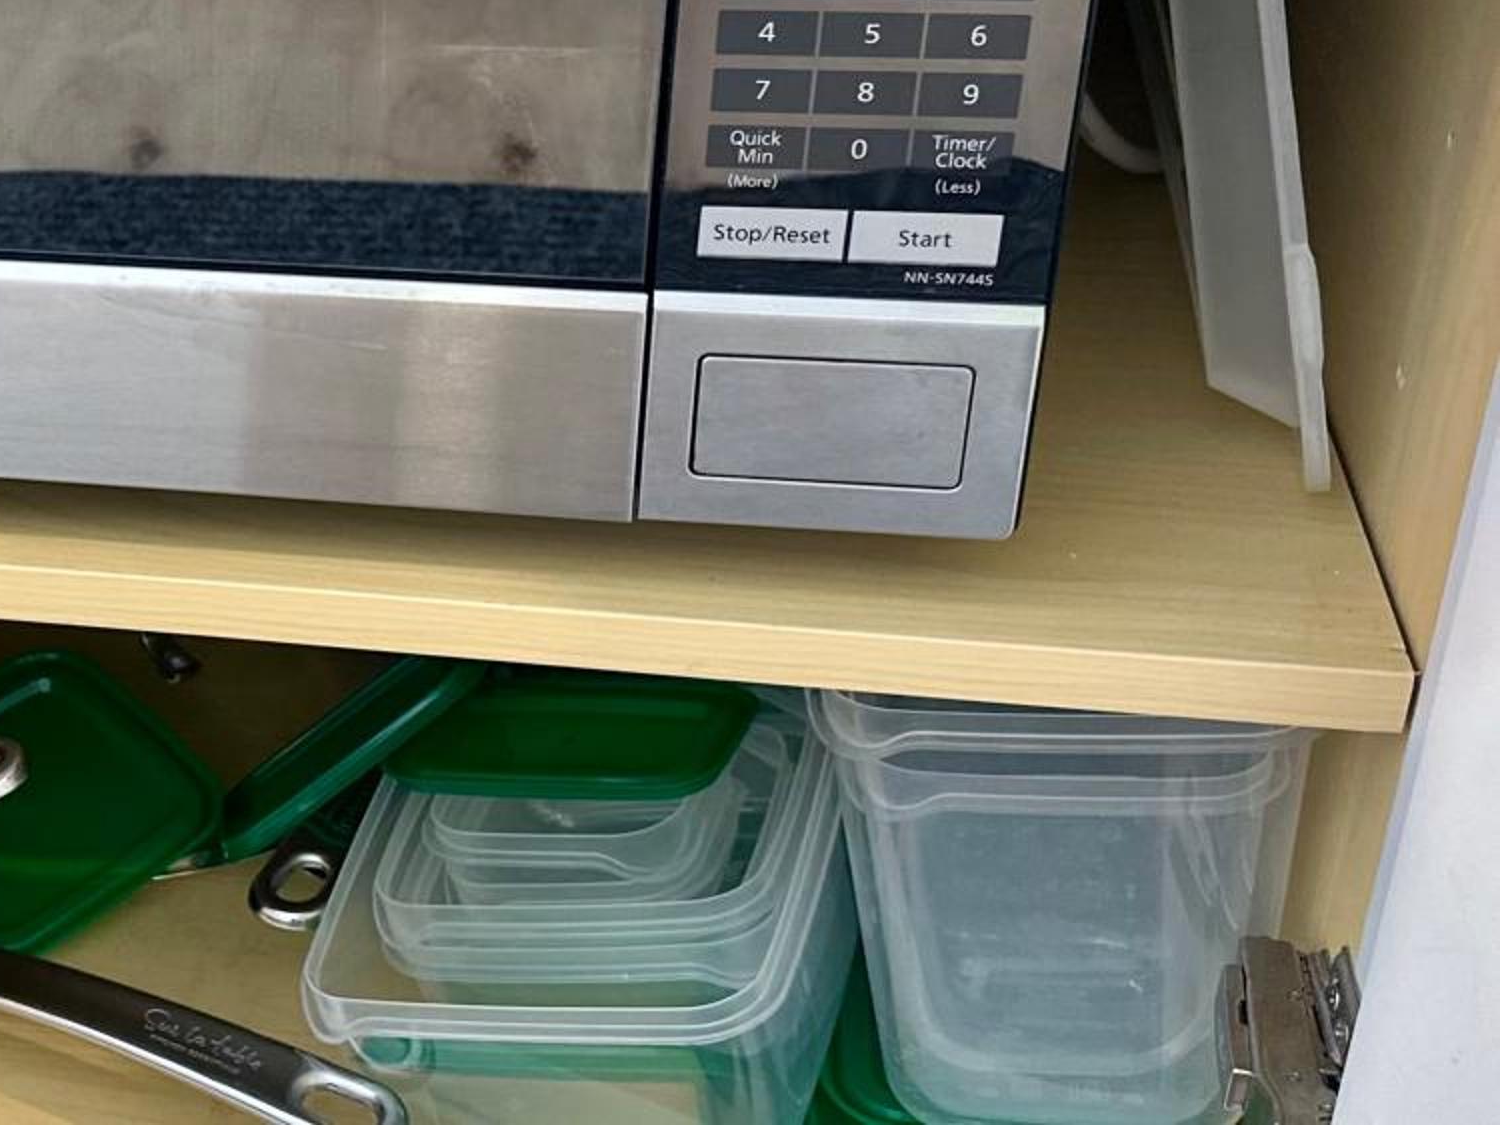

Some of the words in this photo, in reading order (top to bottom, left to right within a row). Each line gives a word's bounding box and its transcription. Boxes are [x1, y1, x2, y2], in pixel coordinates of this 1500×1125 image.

[757, 21, 776, 43] 4
[864, 23, 882, 45] 5
[970, 24, 988, 47] 6
[754, 79, 772, 100] 7
[856, 81, 875, 103] 8
[962, 83, 980, 106] 9
[729, 130, 782, 148] Quick
[850, 138, 868, 161] 0
[932, 134, 997, 153] Timer/
[737, 149, 773, 165] Min
[934, 152, 988, 170] Clock
[727, 174, 779, 190] (More)
[934, 178, 982, 196] (Less)
[712, 223, 831, 246] Stop/Reset
[898, 229, 953, 249] Start
